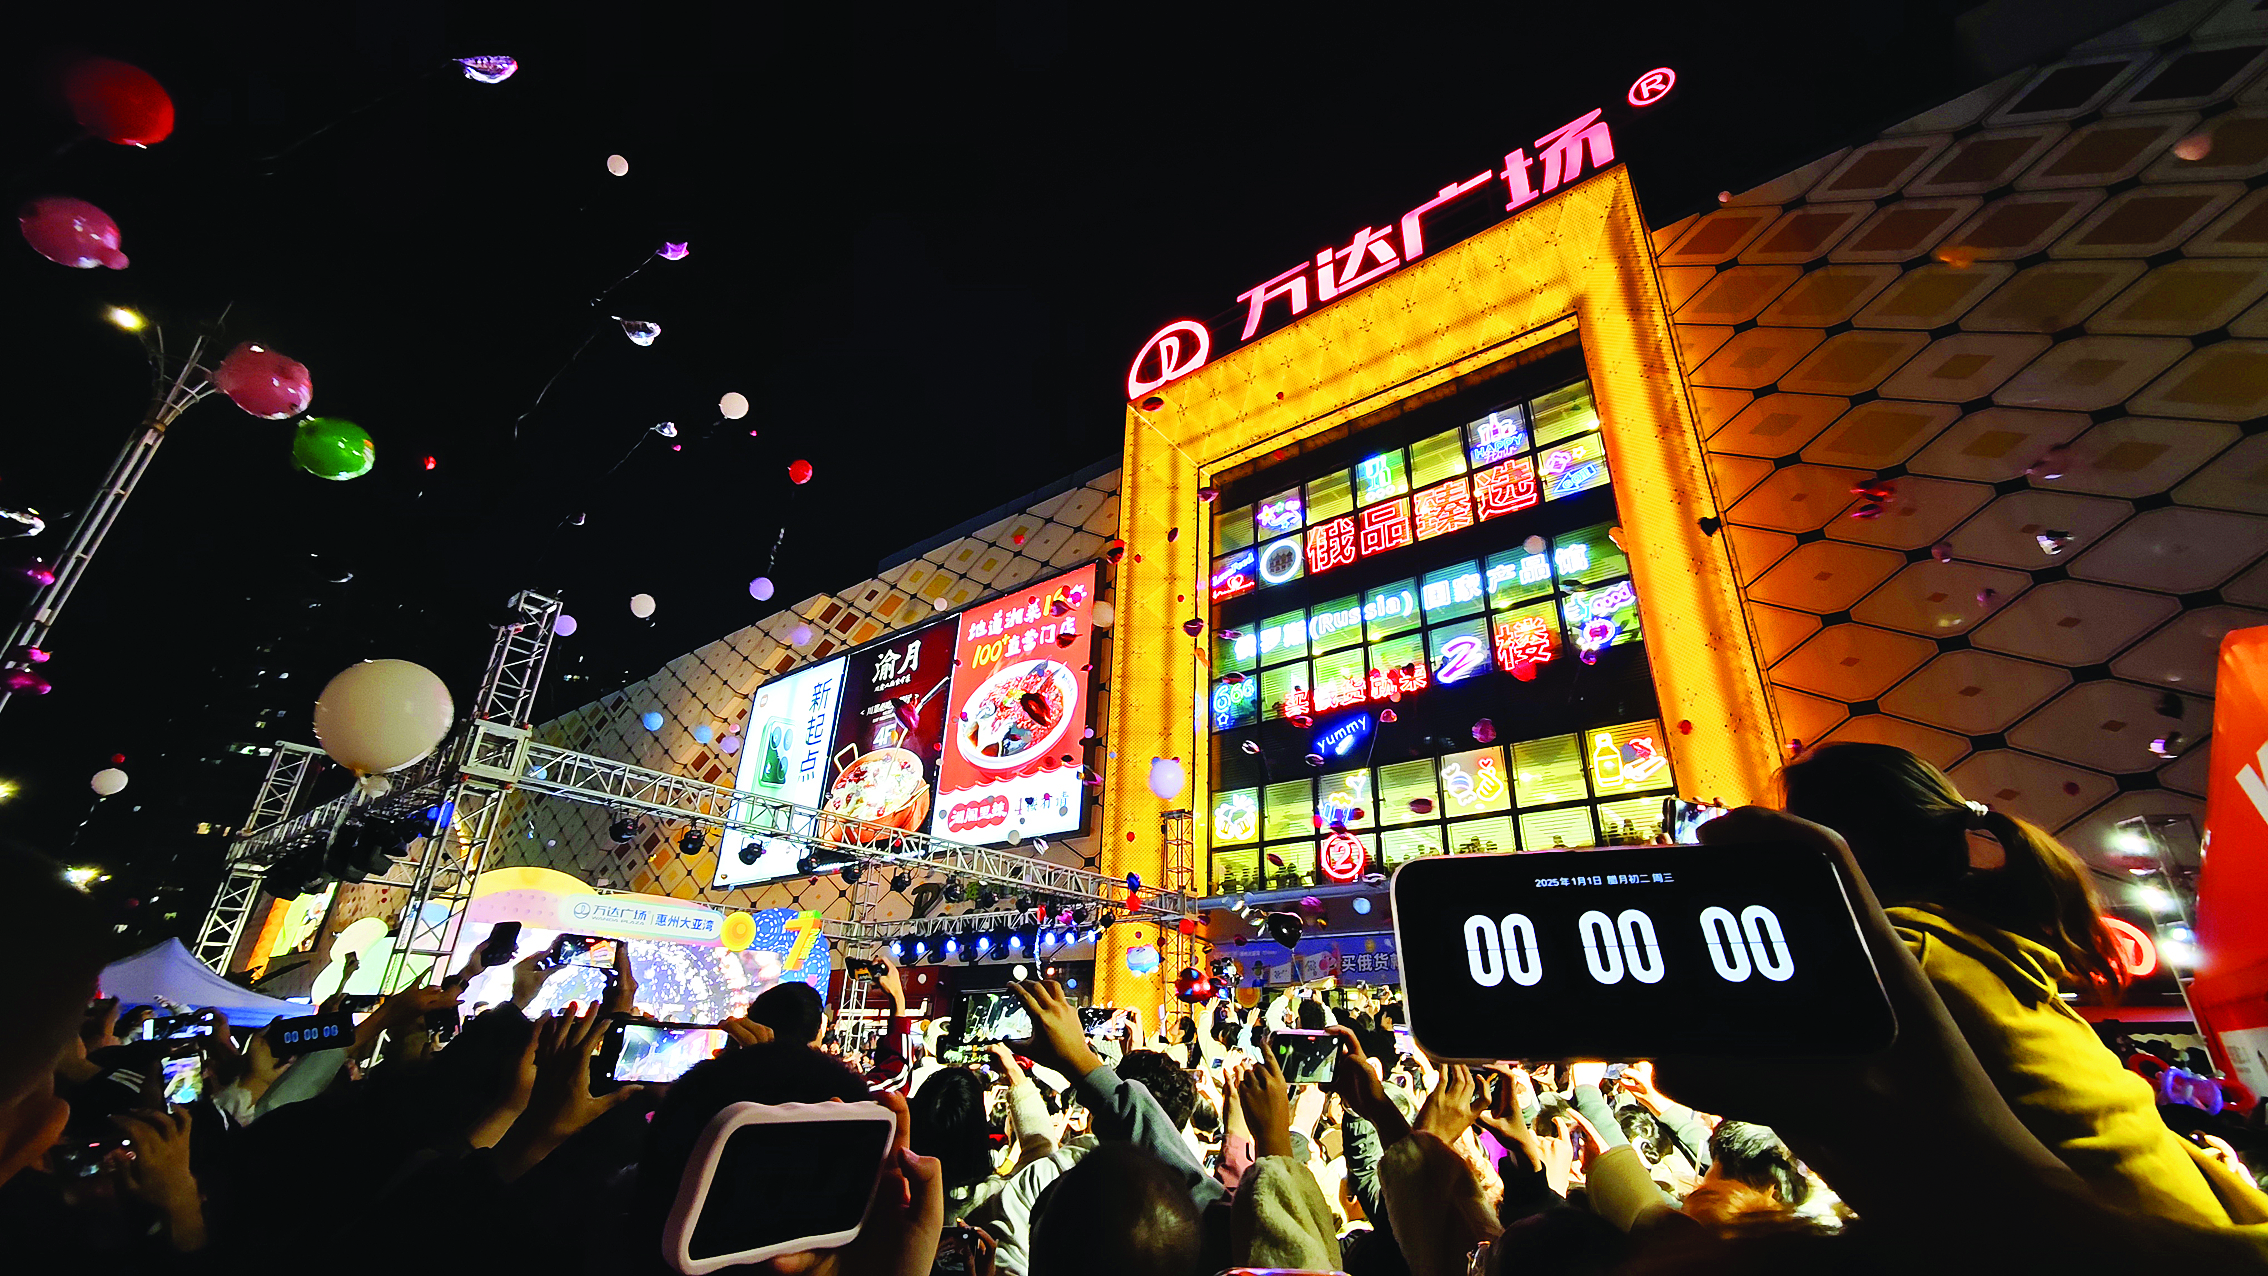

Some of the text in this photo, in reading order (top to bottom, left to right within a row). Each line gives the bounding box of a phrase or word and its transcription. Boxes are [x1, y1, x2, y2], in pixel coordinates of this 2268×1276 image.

[1236, 107, 1615, 341] 万达广场
[1474, 432, 1523, 460] HAPPY
[1306, 459, 1538, 573] 俄品臻选
[1591, 582, 1633, 613] good
[871, 639, 922, 684] 渝月
[1213, 677, 1255, 713] 666
[800, 677, 833, 783] 新起点
[872, 722, 898, 747] 4F
[1316, 713, 1368, 754] yummy
[1534, 875, 1602, 888] 2025年1月1日
[1652, 872, 1675, 884] 周三
[593, 904, 715, 932] 万达广场 惠州大亚湾
[1463, 904, 1795, 987] 00 00 00
